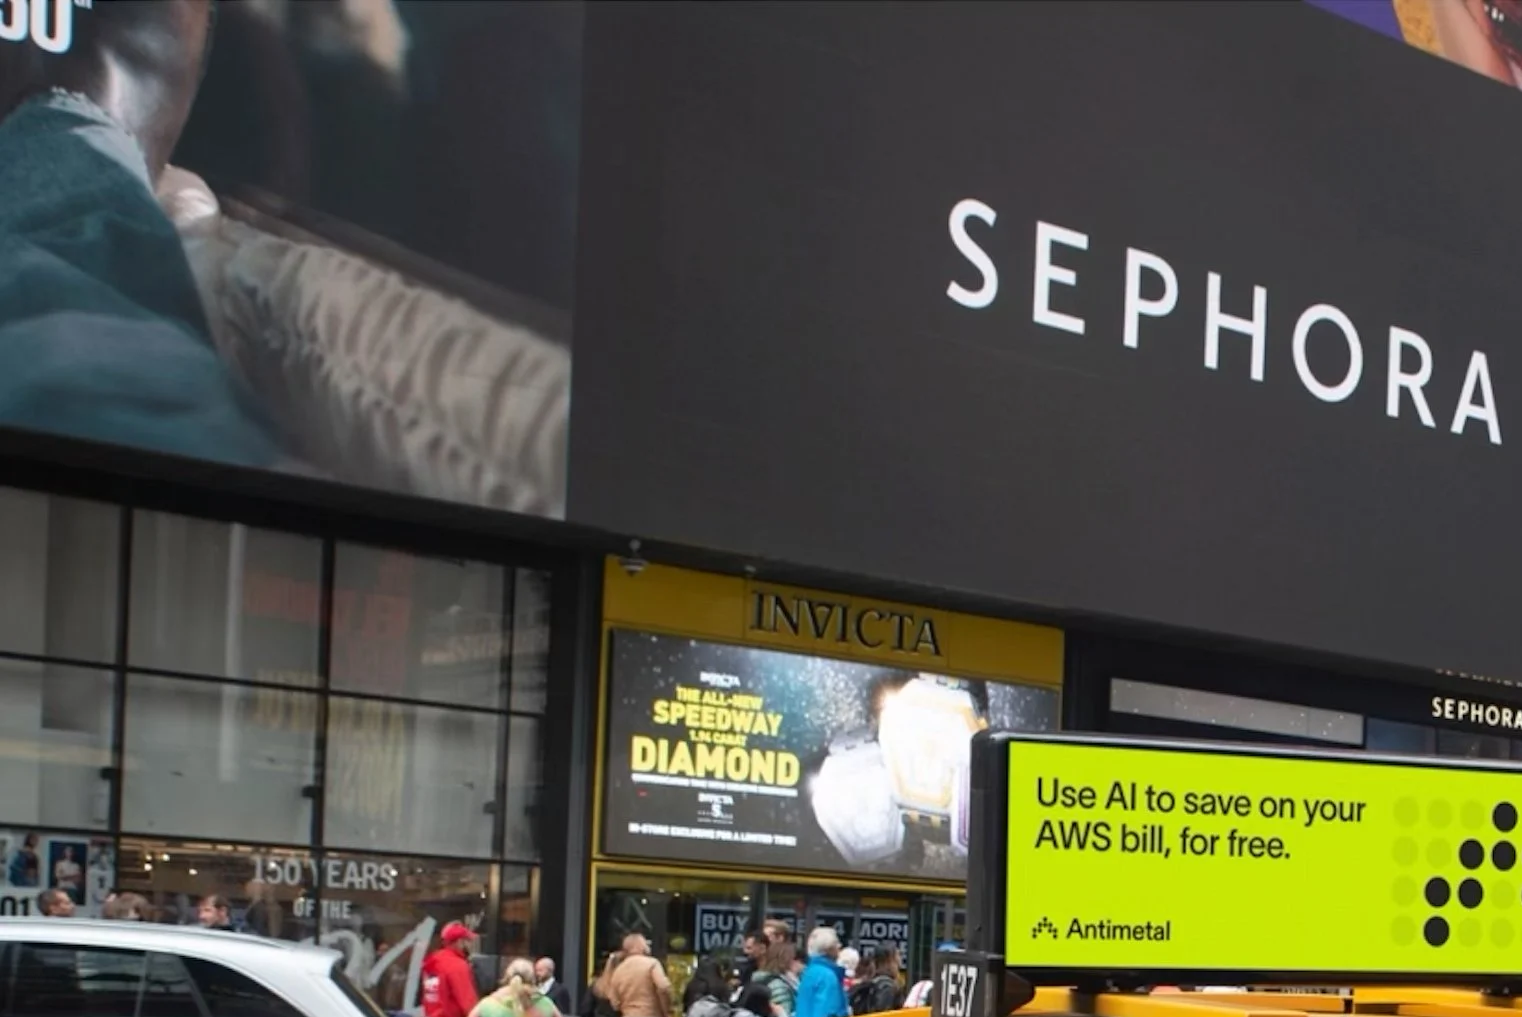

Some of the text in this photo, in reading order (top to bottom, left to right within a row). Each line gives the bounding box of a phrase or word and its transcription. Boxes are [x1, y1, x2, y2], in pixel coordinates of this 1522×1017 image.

[945, 197, 1503, 446] SEPHORA
[751, 591, 941, 656] INVICTA
[653, 699, 784, 737] SPEEDWAY
[631, 735, 801, 787] DIAMOND
[1036, 777, 1367, 828] Use AI to save on your
[1034, 819, 1291, 861] AWS bill, for free.
[251, 856, 301, 886] 150
[321, 900, 351, 920] THE
[702, 912, 749, 932] BUY
[1066, 917, 1171, 942] Antimetal
